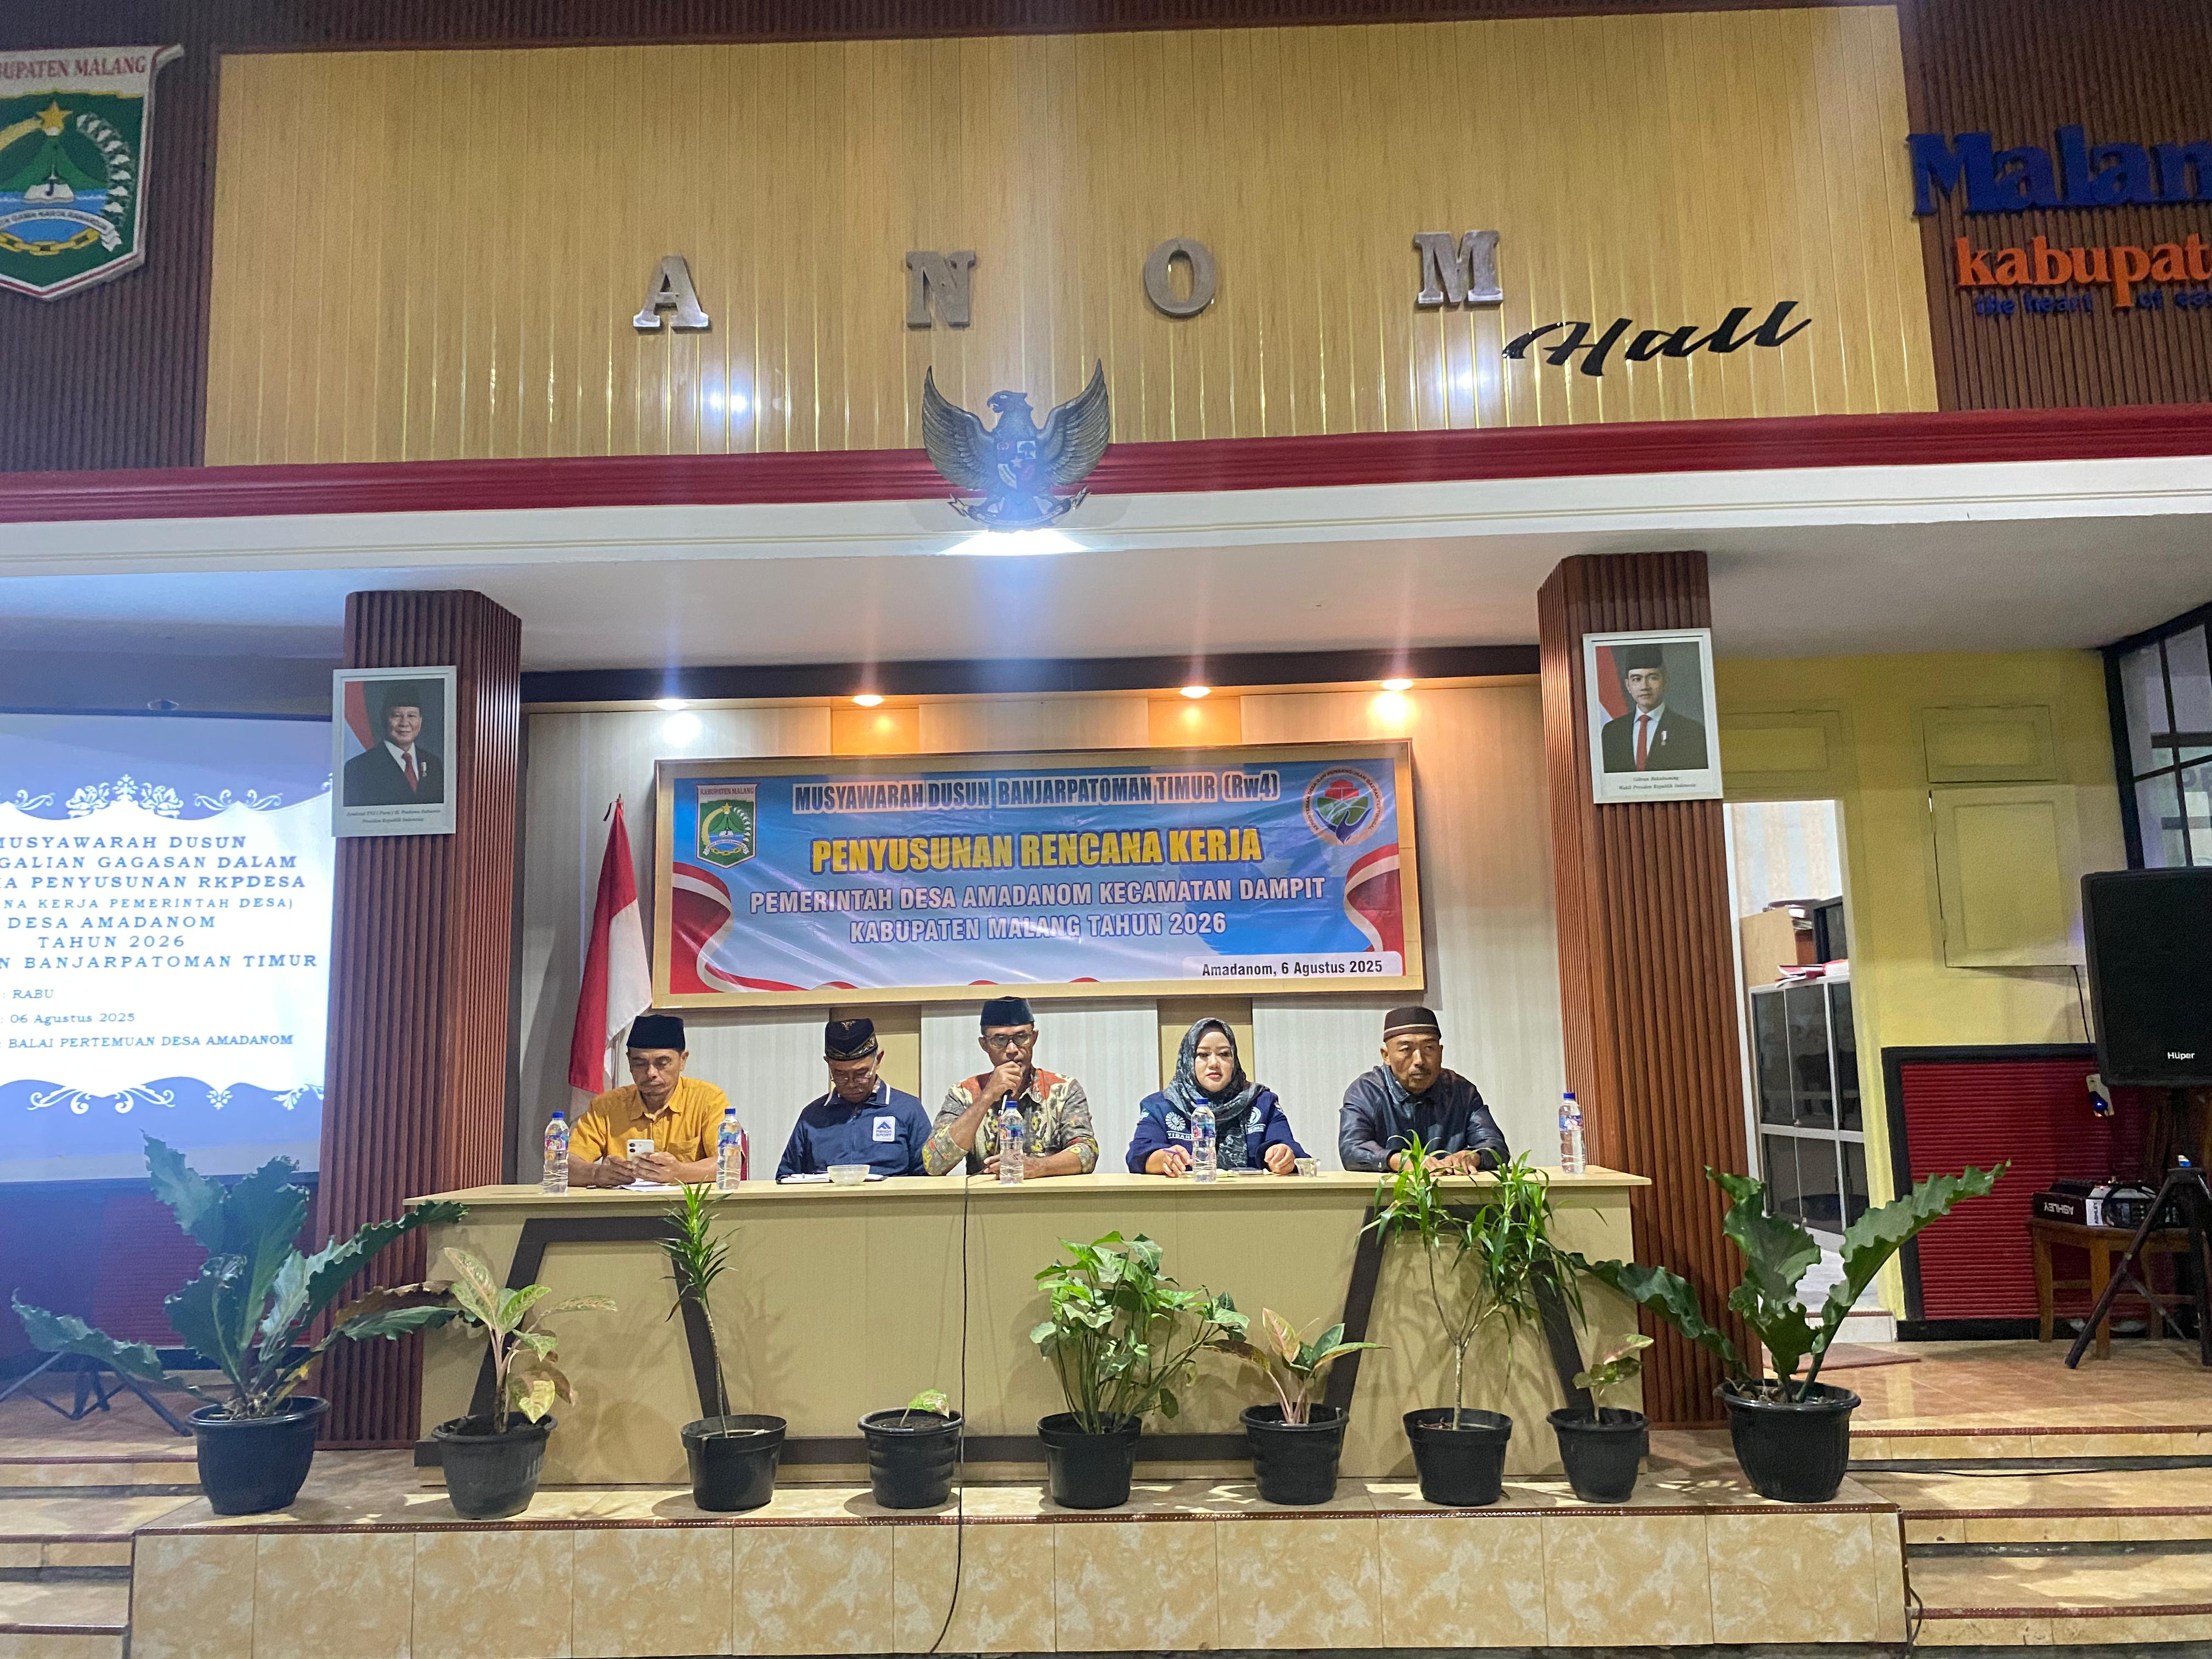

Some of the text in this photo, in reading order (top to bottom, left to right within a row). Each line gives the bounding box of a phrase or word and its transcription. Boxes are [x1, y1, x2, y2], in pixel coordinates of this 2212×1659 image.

[0, 55, 146, 79] UPATEN MALANG
[1906, 125, 2212, 215] Malan
[1502, 301, 1812, 376] Hall
[794, 773, 1278, 811] MUSYAWARAH DUSUN BANJARPATOMAN TIMUR (Rw4)
[168, 836, 246, 848] DUSUN
[812, 828, 1263, 873] PENYUSUNAN RENCANA KERJA
[0, 855, 297, 868] GALIAN GAGASAN DALAM
[31, 876, 187, 888] PENYUSUNAN
[198, 876, 306, 888] RKPDESA
[750, 877, 1326, 913] PEMERINTAH DESA AMADANOM KECAMATAN DAMPIT
[3, 898, 292, 910] NA KERJA PEMERINTAH DESA)
[8, 916, 216, 928] DESA AMADANOM
[850, 911, 1227, 943] KABUPATEN MALANG TAHUN 2026
[37, 935, 184, 948] TAHUN 2026
[24, 956, 232, 969] BANJARPATOMAN
[242, 955, 317, 967] TIMUR
[1202, 960, 1383, 977] Amadanom, 6 Agustus 2025
[12, 989, 54, 999] RABU
[10, 1014, 28, 1023] 06
[33, 1014, 93, 1026] Agustus
[99, 1013, 136, 1023] 2025
[8, 1035, 295, 1048] BALAI PERTEMUAN DESA AMADANOM
[2044, 1202, 2074, 1216] ASHLEY
